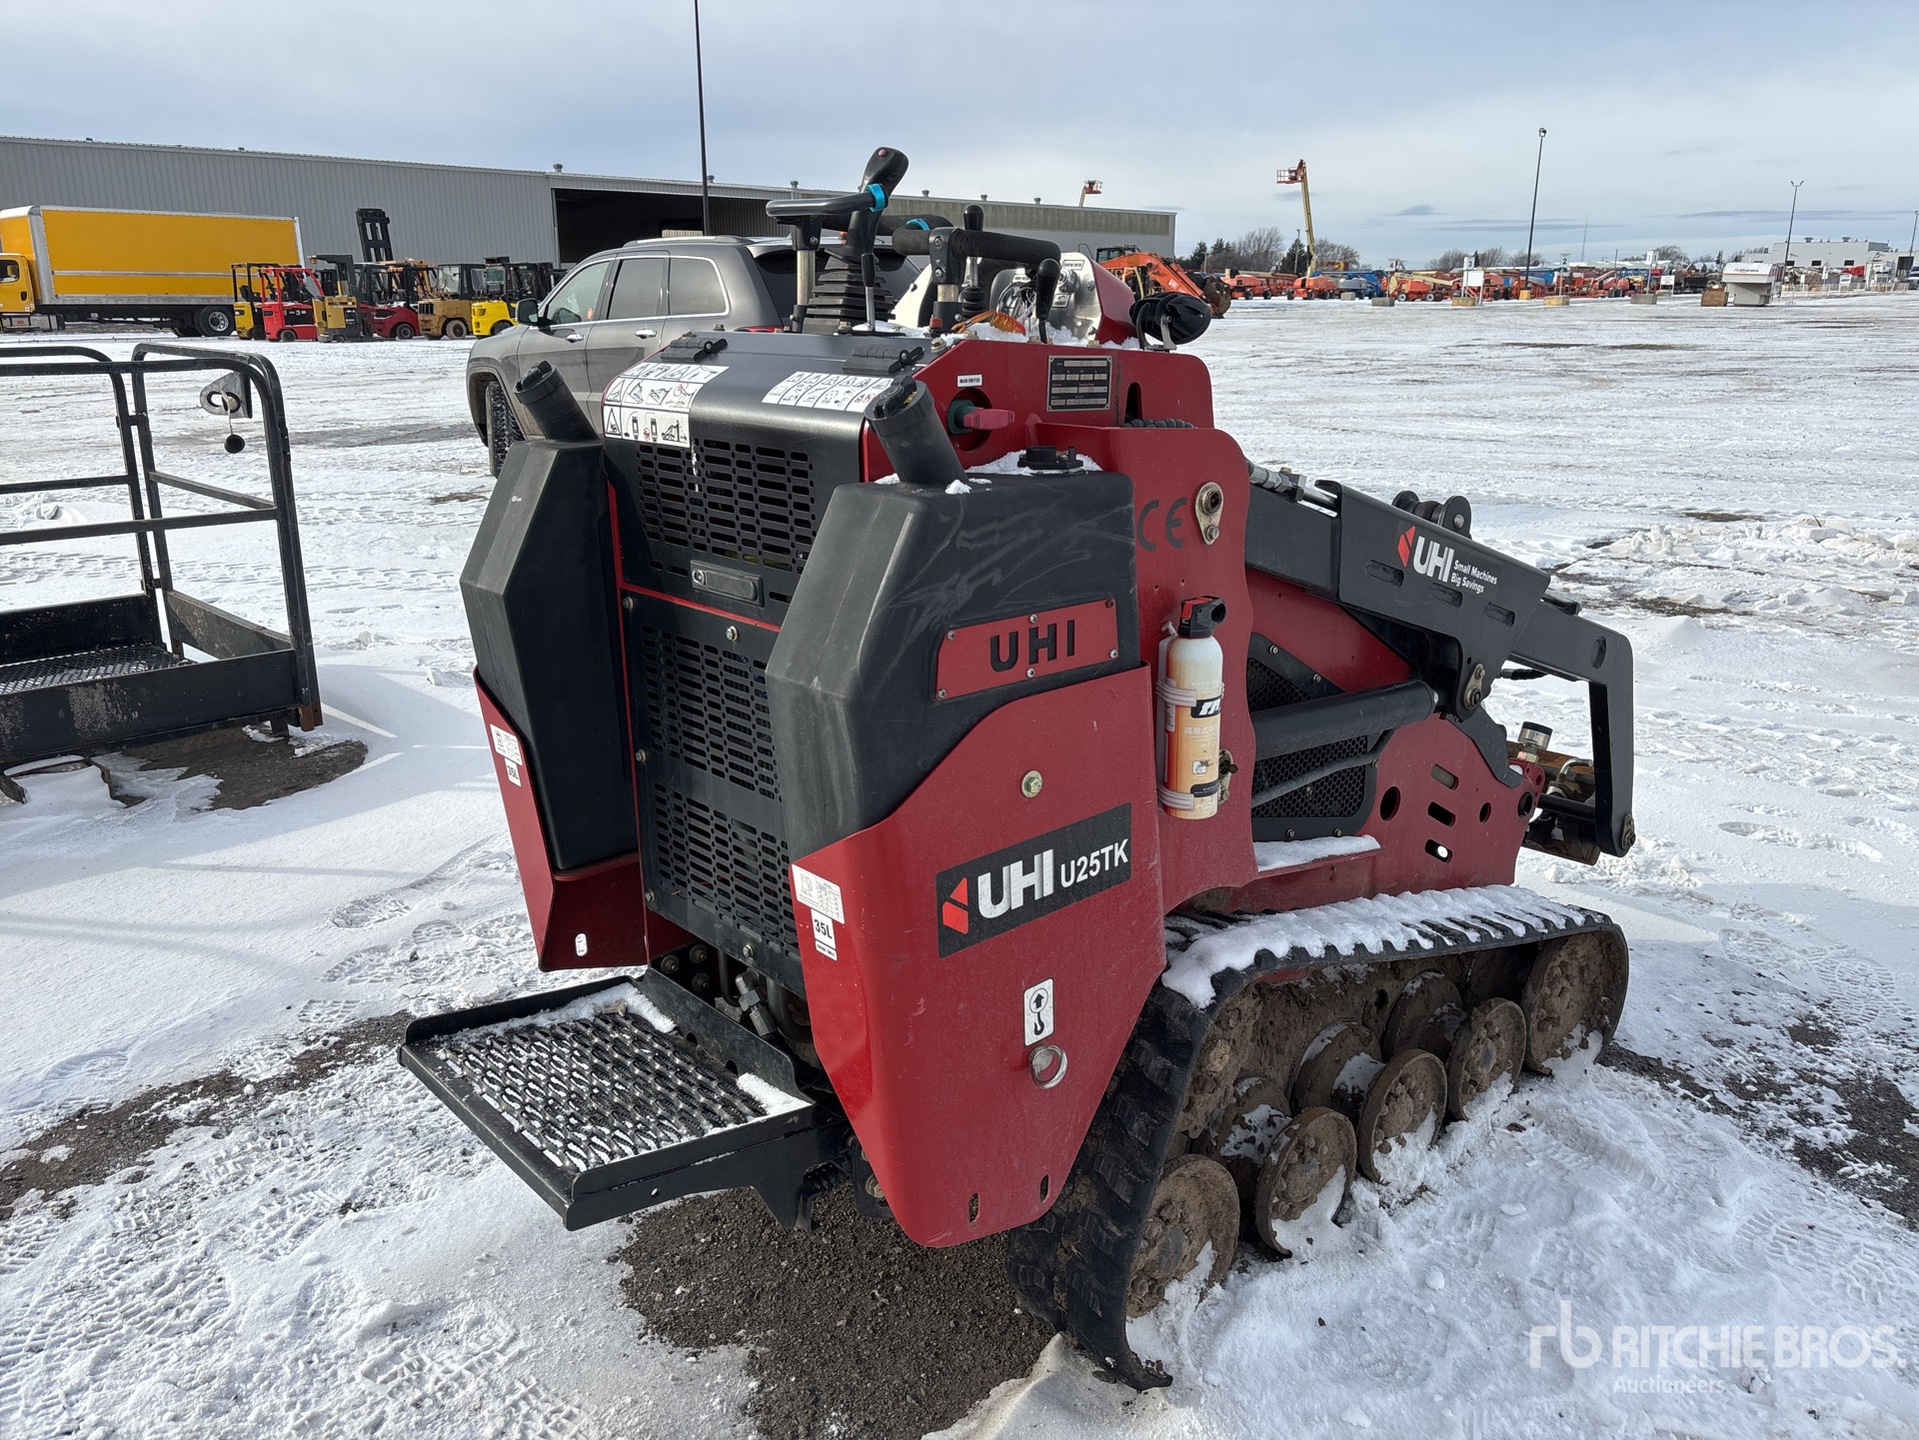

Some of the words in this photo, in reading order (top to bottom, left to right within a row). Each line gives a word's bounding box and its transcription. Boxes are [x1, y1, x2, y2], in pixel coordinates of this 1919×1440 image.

[1138, 496, 1187, 552] CE
[1413, 535, 1455, 583] UHI
[1450, 572, 1461, 587] Big
[1461, 577, 1485, 594] Savings
[1453, 560, 1470, 575] Small
[1471, 566, 1498, 585] Machines
[990, 619, 1075, 672] UHI
[978, 849, 1054, 919] UHI
[1061, 839, 1129, 888] U25TK
[814, 918, 832, 940] 35L
